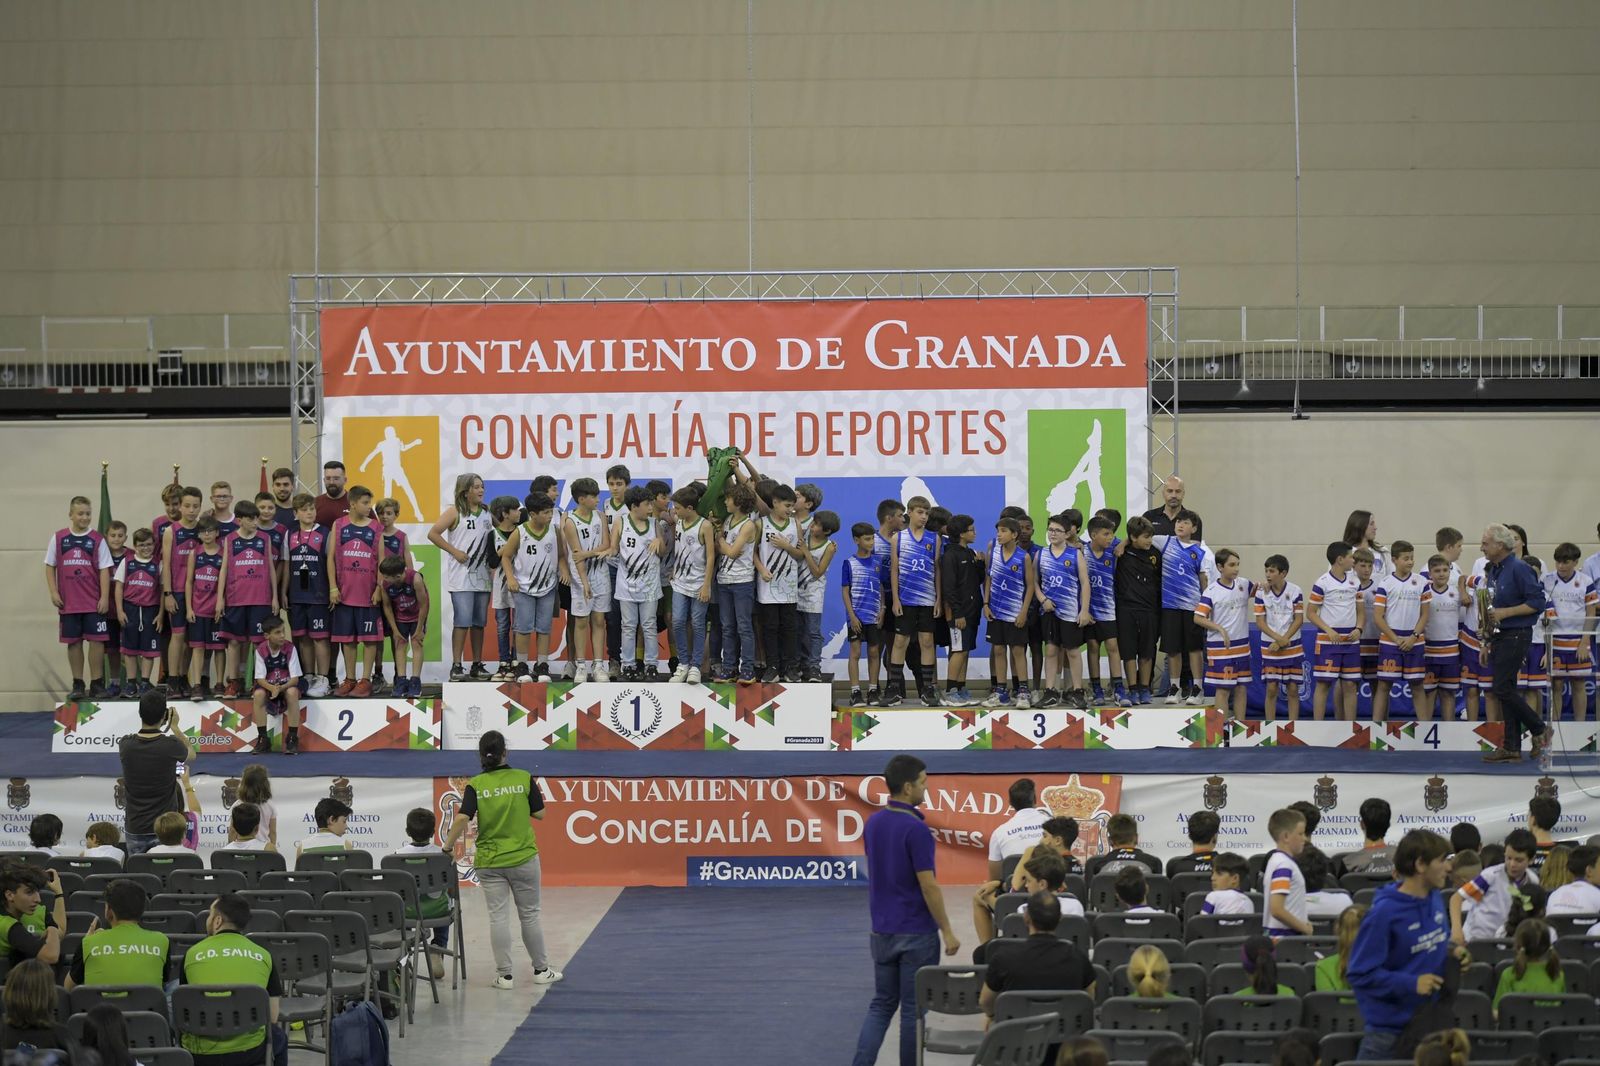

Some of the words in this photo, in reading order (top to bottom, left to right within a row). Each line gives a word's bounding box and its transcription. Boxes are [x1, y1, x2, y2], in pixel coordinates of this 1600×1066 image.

[344, 326, 757, 377] AYUNTAMIENTO
[776, 336, 845, 371] DE
[865, 319, 1126, 371] GRANADA
[460, 399, 708, 460] CONCEJALÍA
[728, 412, 777, 457] DE
[796, 408, 1007, 457] DEPORTES
[467, 519, 476, 530] 21
[581, 528, 590, 539] 15
[626, 537, 636, 548] 53
[526, 545, 537, 555] 45
[912, 559, 925, 571] 23
[1177, 563, 1185, 575] 5
[1000, 580, 1008, 591] 6
[1049, 576, 1063, 588] 29
[97, 622, 107, 632] 30
[313, 619, 324, 629] 34
[364, 621, 373, 632] 77
[630, 695, 641, 731] 1
[338, 709, 354, 741] 2
[1033, 713, 1046, 738] 3
[1424, 723, 1441, 749] 4
[804, 778, 846, 801] DE
[1397, 814, 1476, 823] AYUNTAMIENTO
[566, 809, 772, 845] CONCEJALÍA
[786, 819, 821, 843] DE
[1007, 826, 1023, 836] LUX
[700, 860, 857, 881] #GRANADA2031
[91, 944, 114, 956] C.D.
[119, 944, 160, 956] SMILO
[195, 949, 218, 961] C.D.
[222, 948, 263, 961] SMILO
